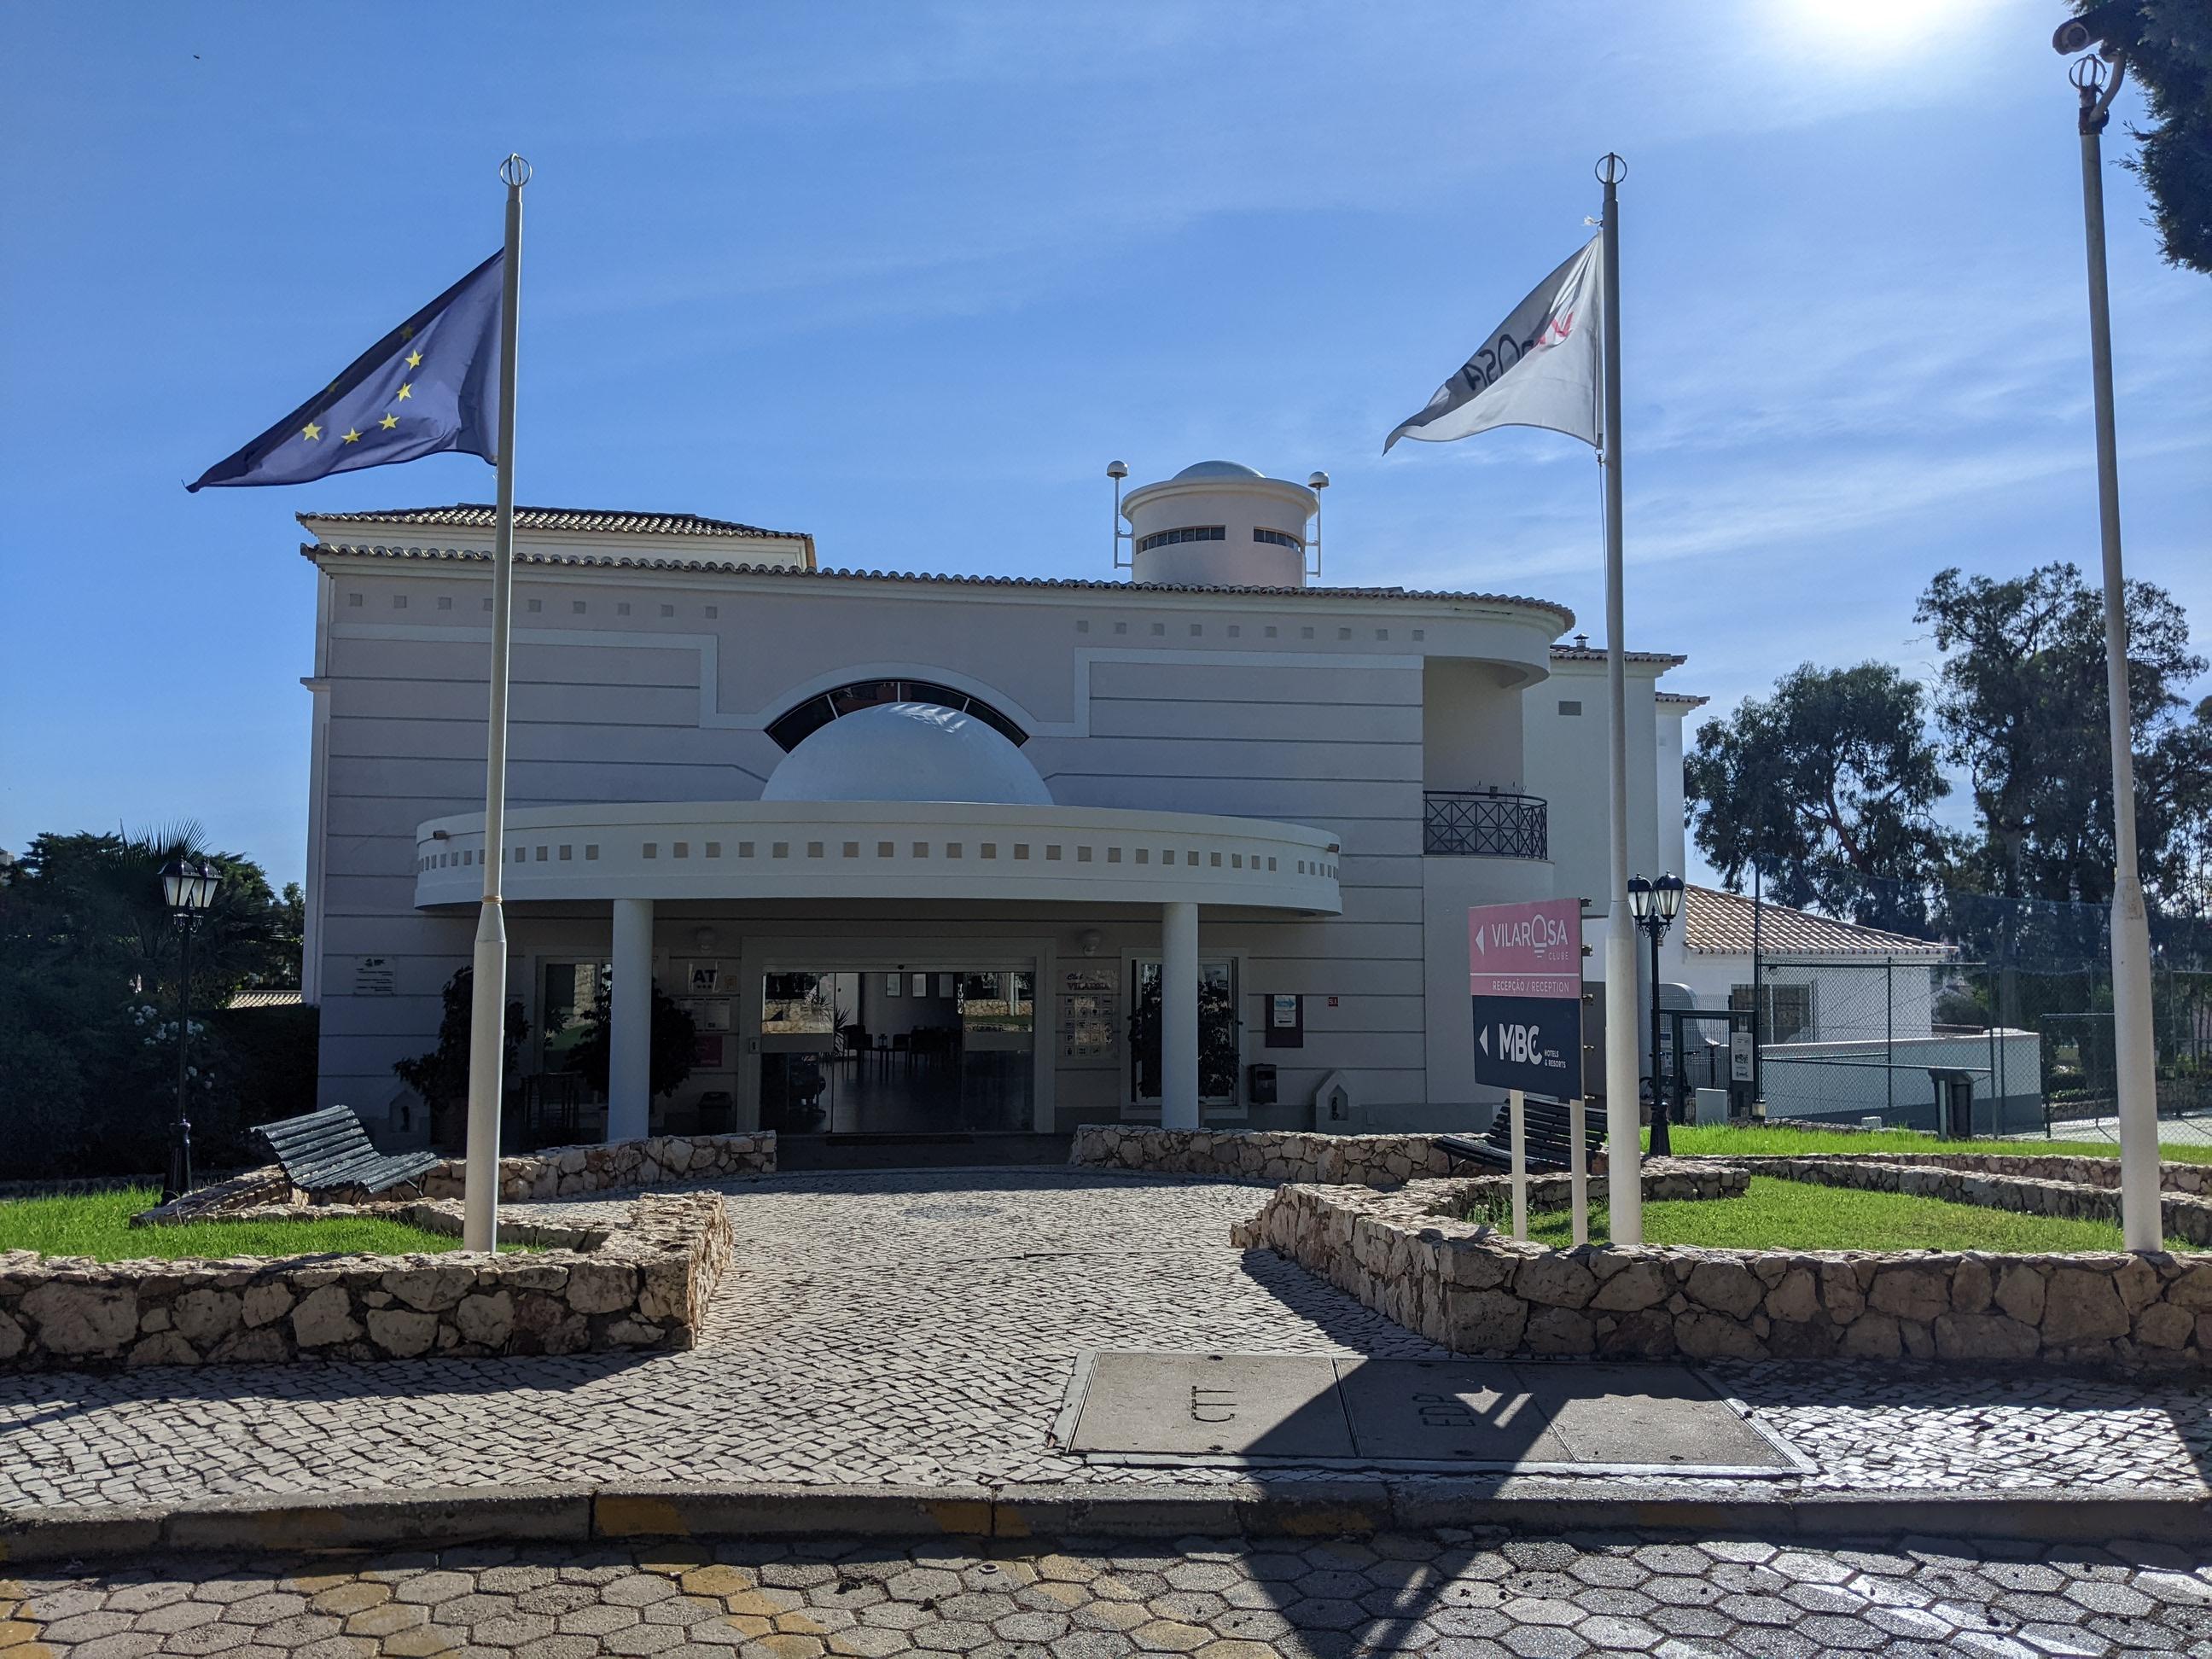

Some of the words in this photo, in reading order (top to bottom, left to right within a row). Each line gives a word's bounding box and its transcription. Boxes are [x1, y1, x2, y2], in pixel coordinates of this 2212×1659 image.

[1491, 914, 1569, 948] VILAROSA
[1548, 952, 1569, 961] CLUBE
[693, 969, 717, 983] AT
[1493, 978, 1525, 993] RECEPÇÃO
[1531, 981, 1570, 992] RECEPTION
[1499, 1023, 1543, 1065] MBC
[1544, 1049, 1559, 1058] HOTELS
[1548, 1059, 1567, 1068] RESORTS
[1412, 1392, 1476, 1427] EDP
